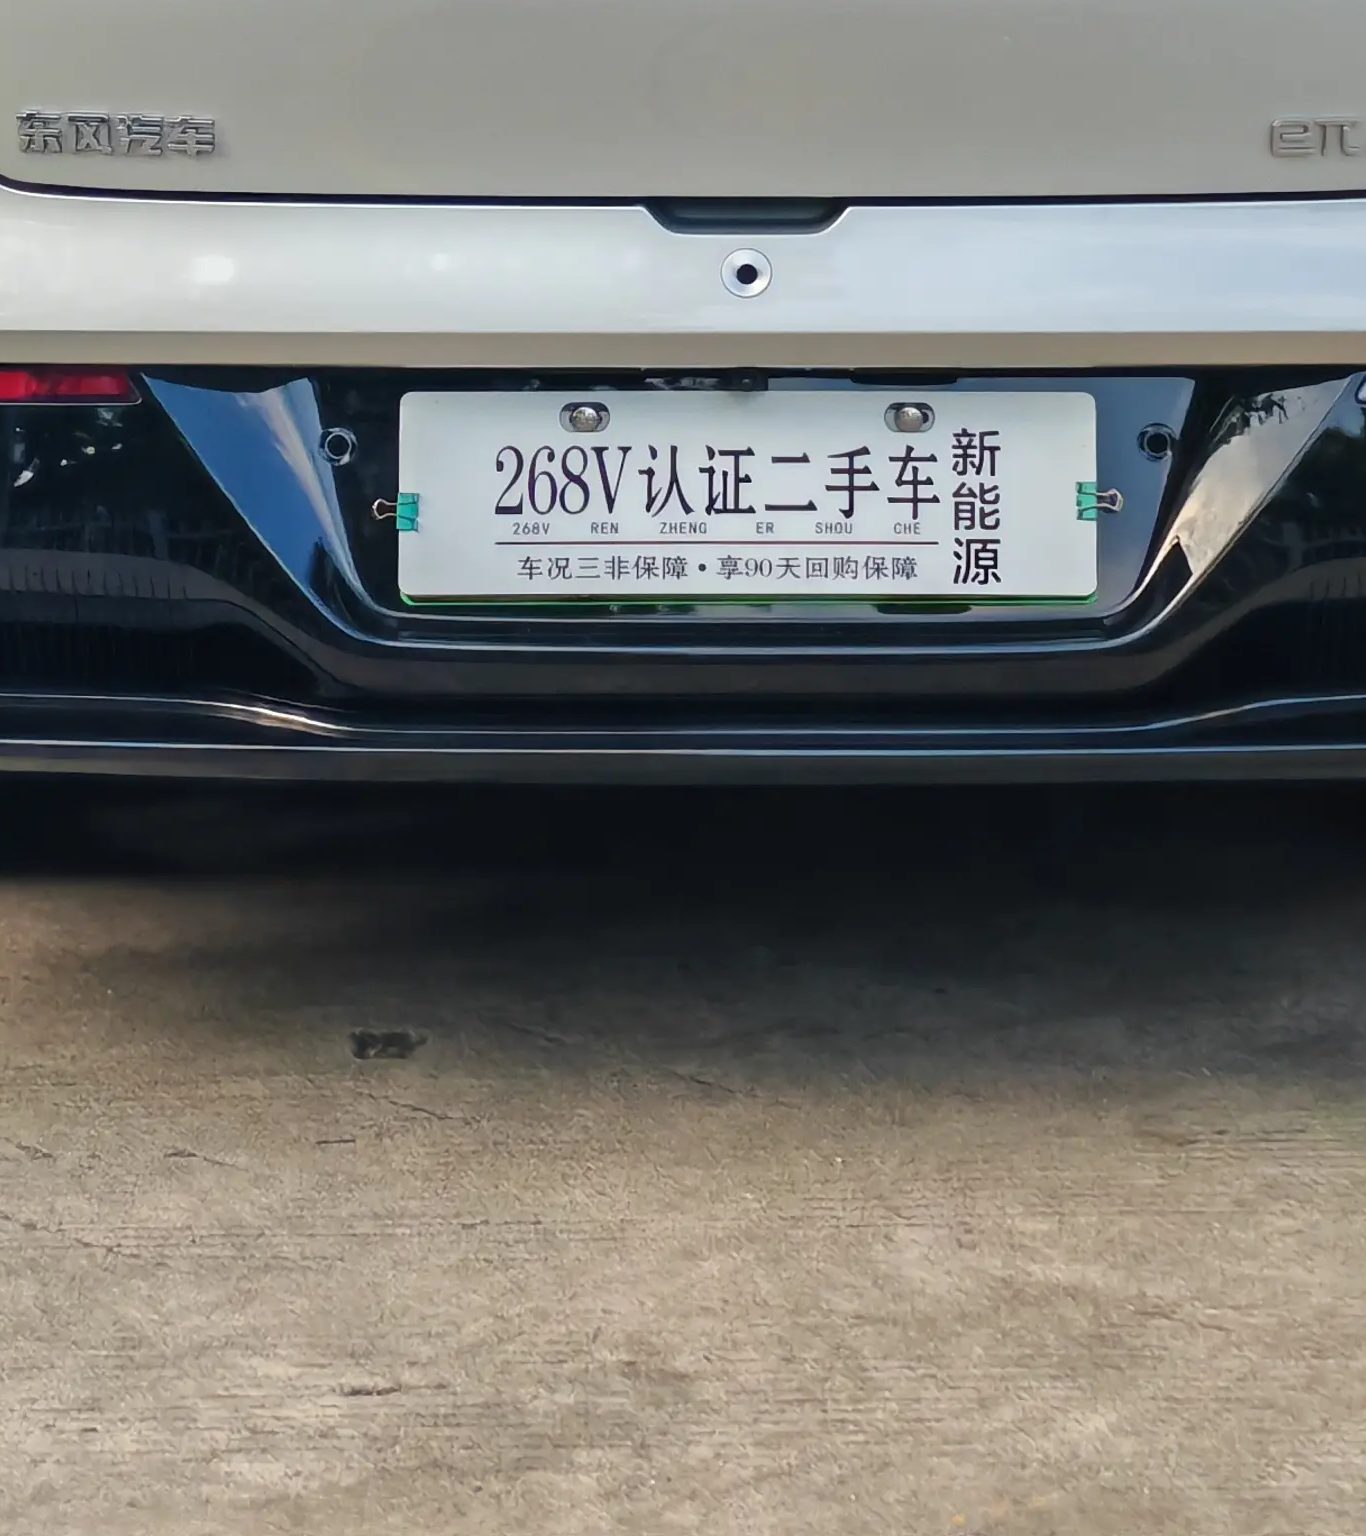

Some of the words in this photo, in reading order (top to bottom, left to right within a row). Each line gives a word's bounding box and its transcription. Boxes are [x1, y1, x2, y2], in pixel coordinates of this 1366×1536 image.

[16, 109, 216, 157] 东风汽车
[512, 521, 551, 535] 268V
[590, 521, 619, 534] REN
[659, 521, 708, 534] ZHENG
[756, 521, 775, 535] ER
[815, 521, 853, 534] SHOU
[893, 521, 921, 534] CHE
[951, 428, 1002, 585] 新能源
